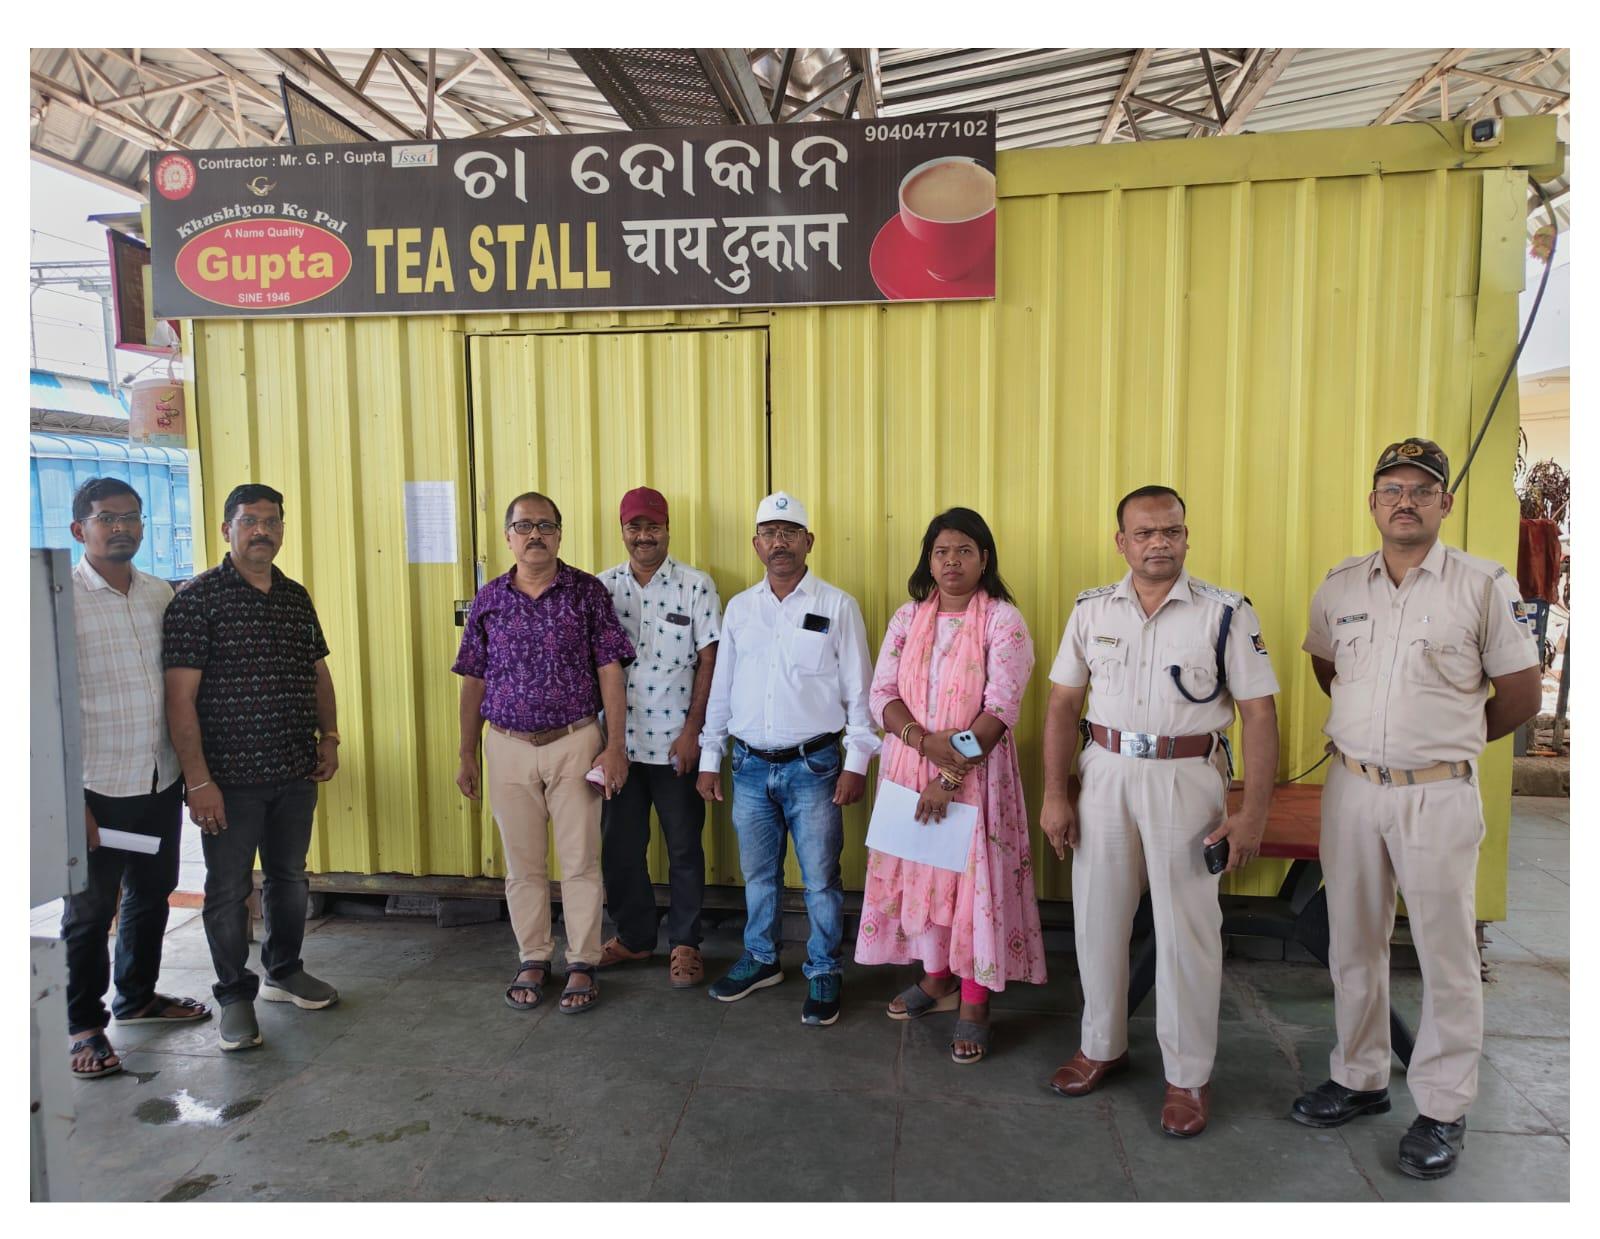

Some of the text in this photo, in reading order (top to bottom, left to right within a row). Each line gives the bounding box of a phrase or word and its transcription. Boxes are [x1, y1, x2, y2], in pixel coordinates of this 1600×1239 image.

[865, 120, 988, 142] 9040477102
[198, 156, 268, 170] Contractor
[280, 153, 302, 166] Mr.
[305, 152, 321, 165] G.
[343, 151, 386, 166] Gupta
[453, 135, 848, 203] ଚା ଦୋକାନ
[176, 202, 348, 239] Khushiyon Ke Pal
[224, 226, 305, 239] A Name Quality
[197, 245, 334, 289] Gupta
[367, 222, 611, 294] TEA STALL
[621, 213, 849, 295] चाय दुकान
[238, 291, 291, 304] SINE 1946
